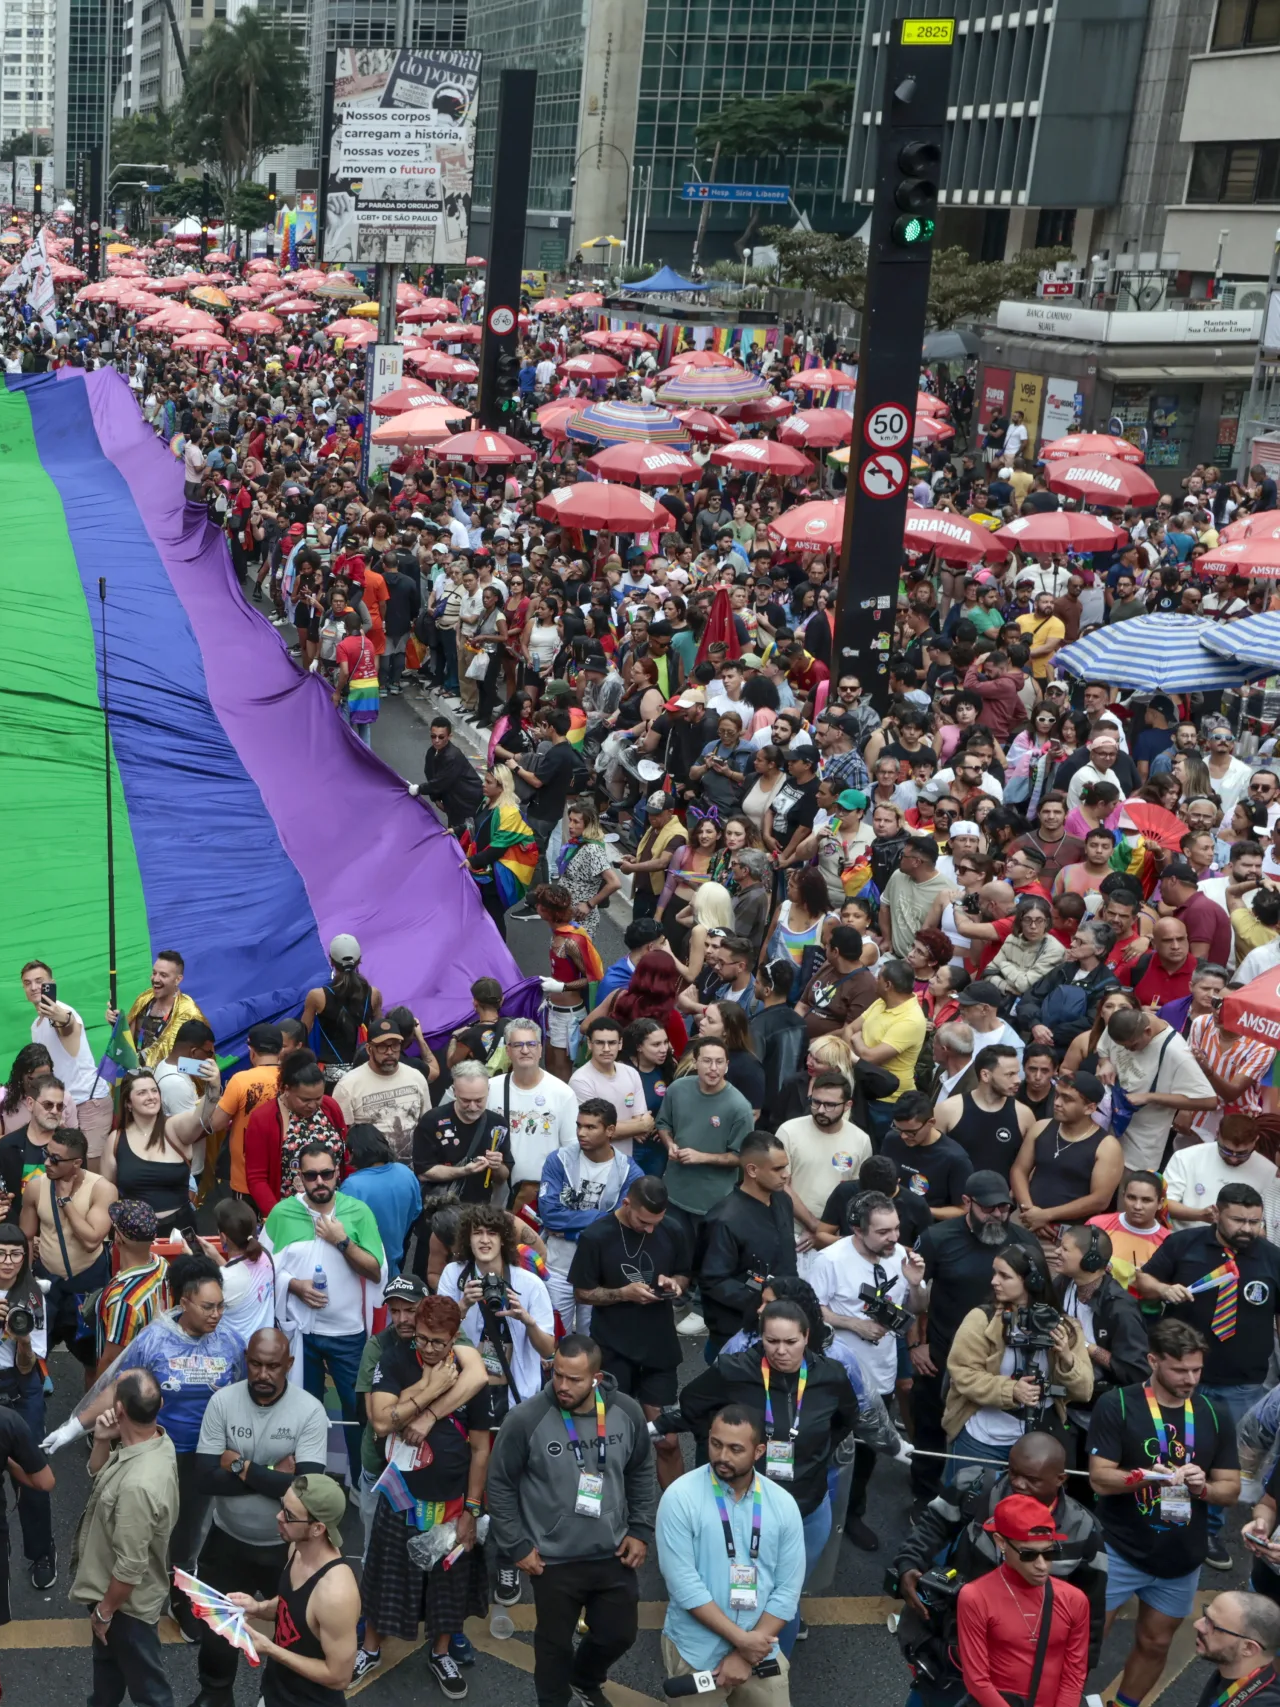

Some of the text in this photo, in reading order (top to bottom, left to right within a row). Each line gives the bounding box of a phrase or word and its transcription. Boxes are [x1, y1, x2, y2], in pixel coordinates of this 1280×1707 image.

[917, 26, 949, 38] 2825
[399, 57, 464, 86] do povo
[346, 111, 431, 125] Nossos corpos
[344, 129, 462, 142] carregam a história,
[343, 147, 420, 157] nossas vozes
[342, 165, 437, 174] movem o futuro
[394, 213, 411, 221] SÃO
[1026, 307, 1073, 321] BANCA CAMINHO
[1038, 322, 1056, 331] SUAVE
[1188, 326, 1202, 334] Sua
[1230, 326, 1252, 334] Limpa
[985, 387, 1005, 401] SUPER
[873, 413, 904, 435] 50
[879, 435, 899, 443] km/h
[1065, 467, 1122, 492] BRAHMA
[906, 518, 972, 545] BRAHMA
[794, 540, 822, 552] AMSTEL
[1202, 562, 1228, 572] AMSTEL
[396, 1283, 414, 1291] FLOYD
[230, 1425, 253, 1439] 169
